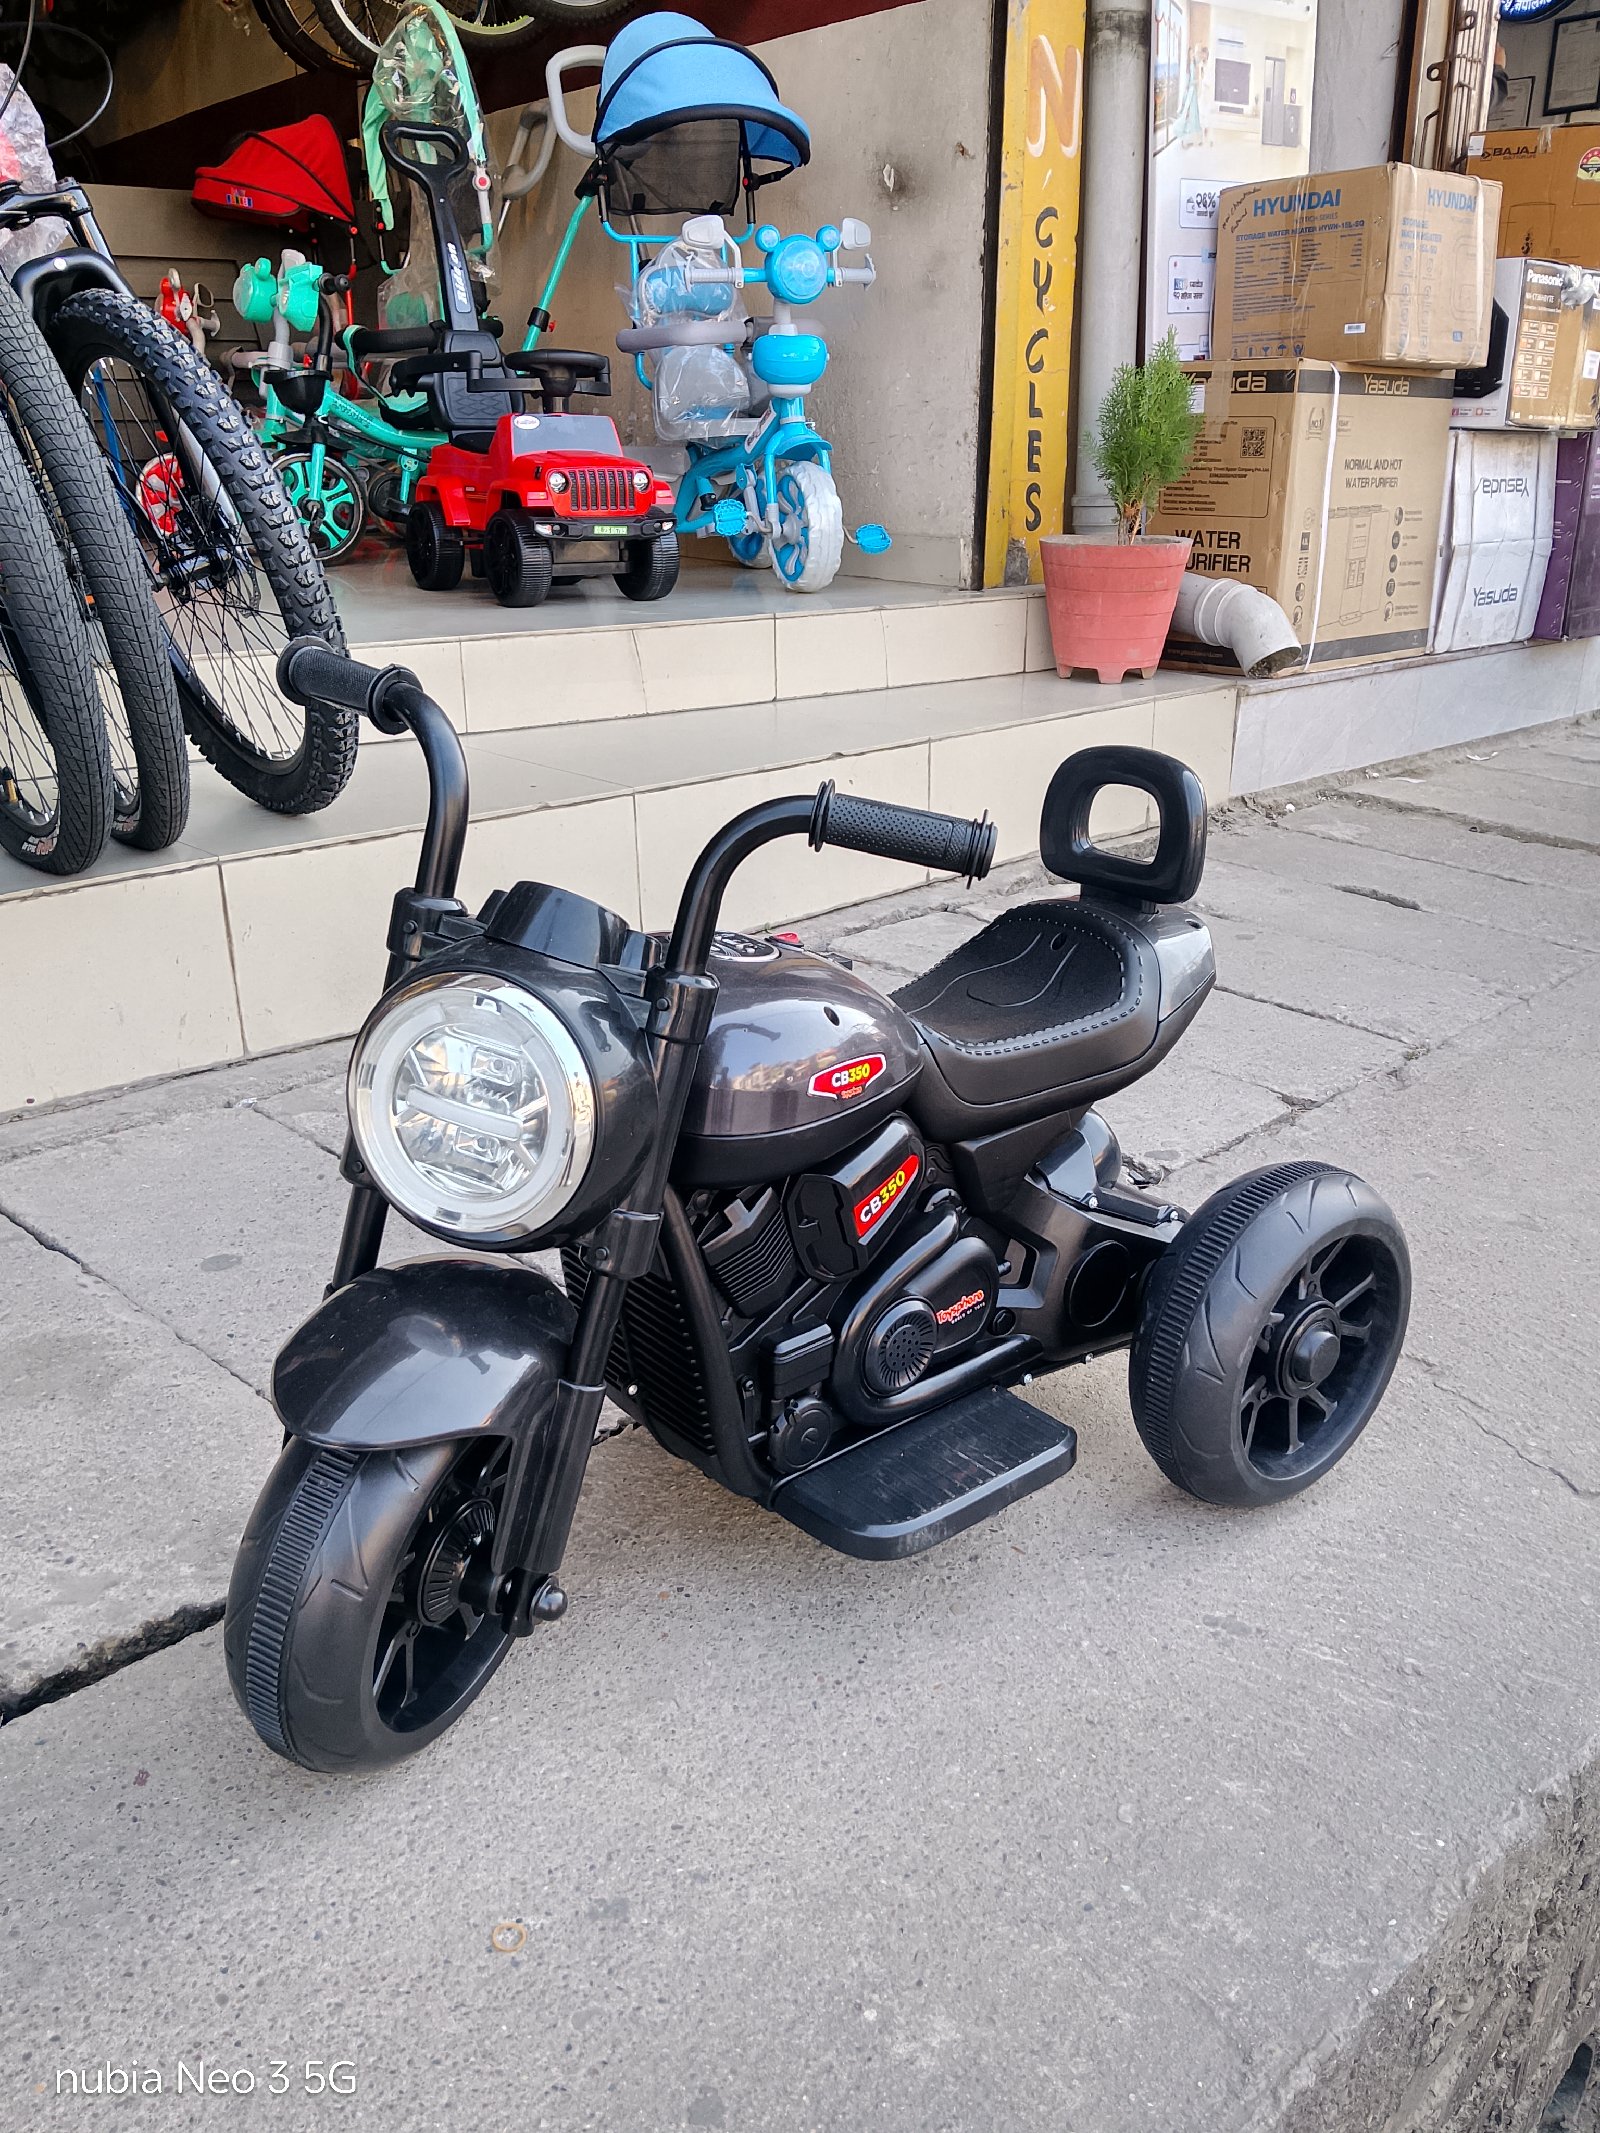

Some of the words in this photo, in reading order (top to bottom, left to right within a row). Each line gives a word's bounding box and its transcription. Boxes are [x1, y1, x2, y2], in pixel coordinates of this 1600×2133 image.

[1492, 145, 1538, 157] BAJAJ
[1253, 188, 1342, 217] HYUNDAI
[1267, 229, 1290, 239] WATER
[1526, 268, 1564, 287] Panasonic
[1025, 206, 1059, 533] CYCLES
[1364, 373, 1410, 396] Yasuda
[1344, 458, 1373, 471] NORMAL
[1374, 459, 1390, 471] AND
[1390, 458, 1403, 471] HOT
[1345, 477, 1370, 489] WATER
[1370, 477, 1398, 489] PURIFIER
[1482, 477, 1530, 499] Yasuda
[1184, 552, 1252, 573] URIFIER
[1472, 582, 1519, 607] Yasuda
[831, 1062, 871, 1088] CB350
[860, 1170, 906, 1223] CB350
